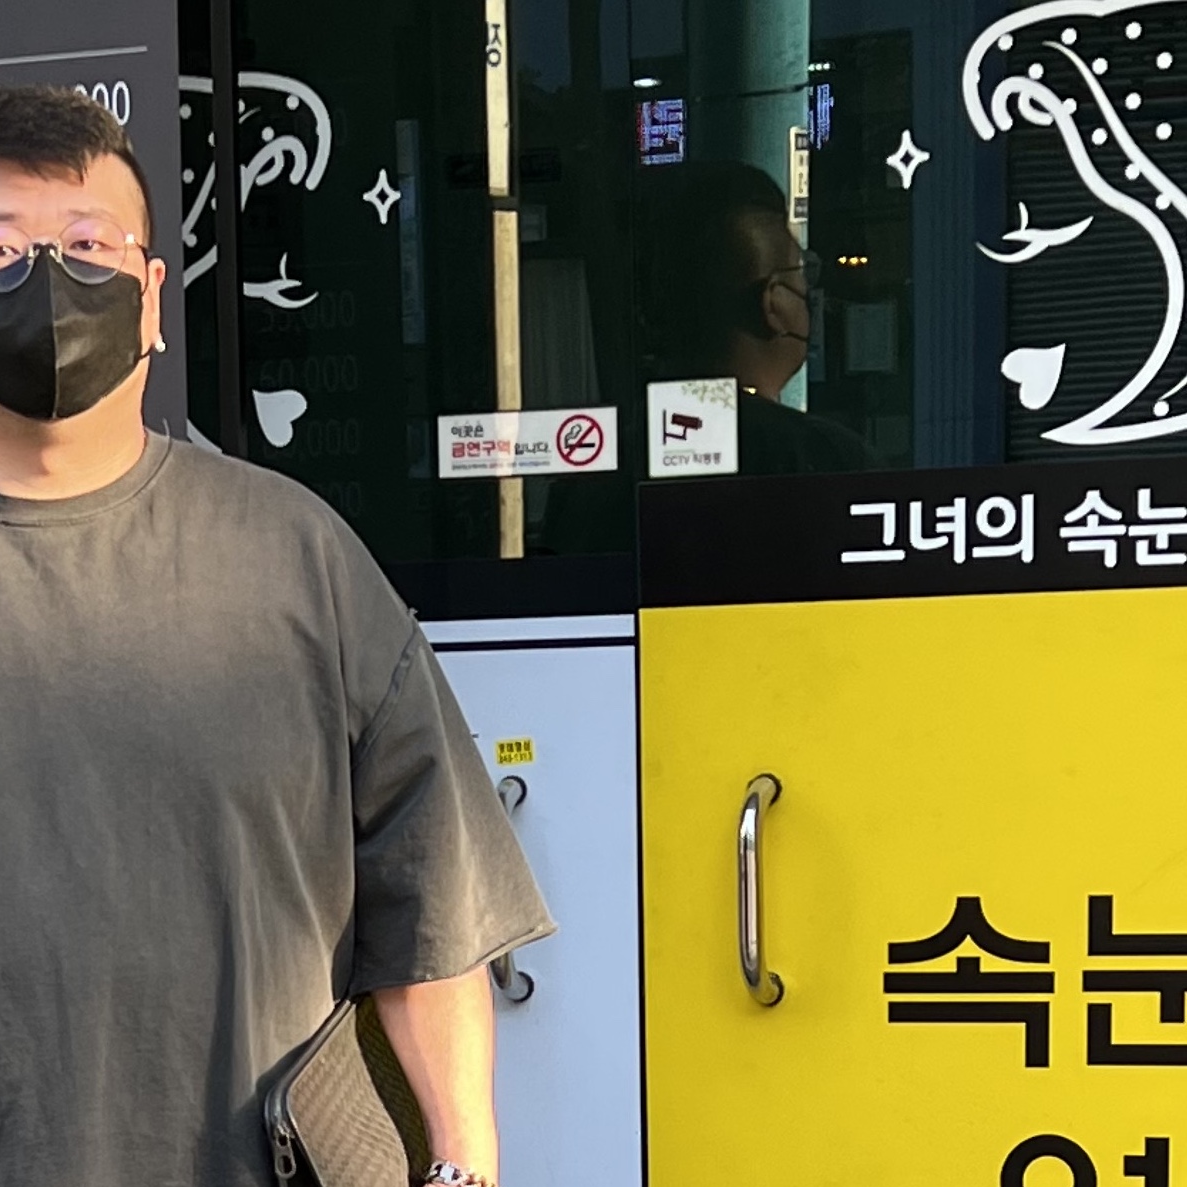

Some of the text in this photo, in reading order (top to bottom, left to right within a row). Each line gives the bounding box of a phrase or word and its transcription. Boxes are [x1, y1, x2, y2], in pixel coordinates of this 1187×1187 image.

[662, 455, 690, 467] CCTV
[840, 488, 1187, 568] 그녀의 속눈
